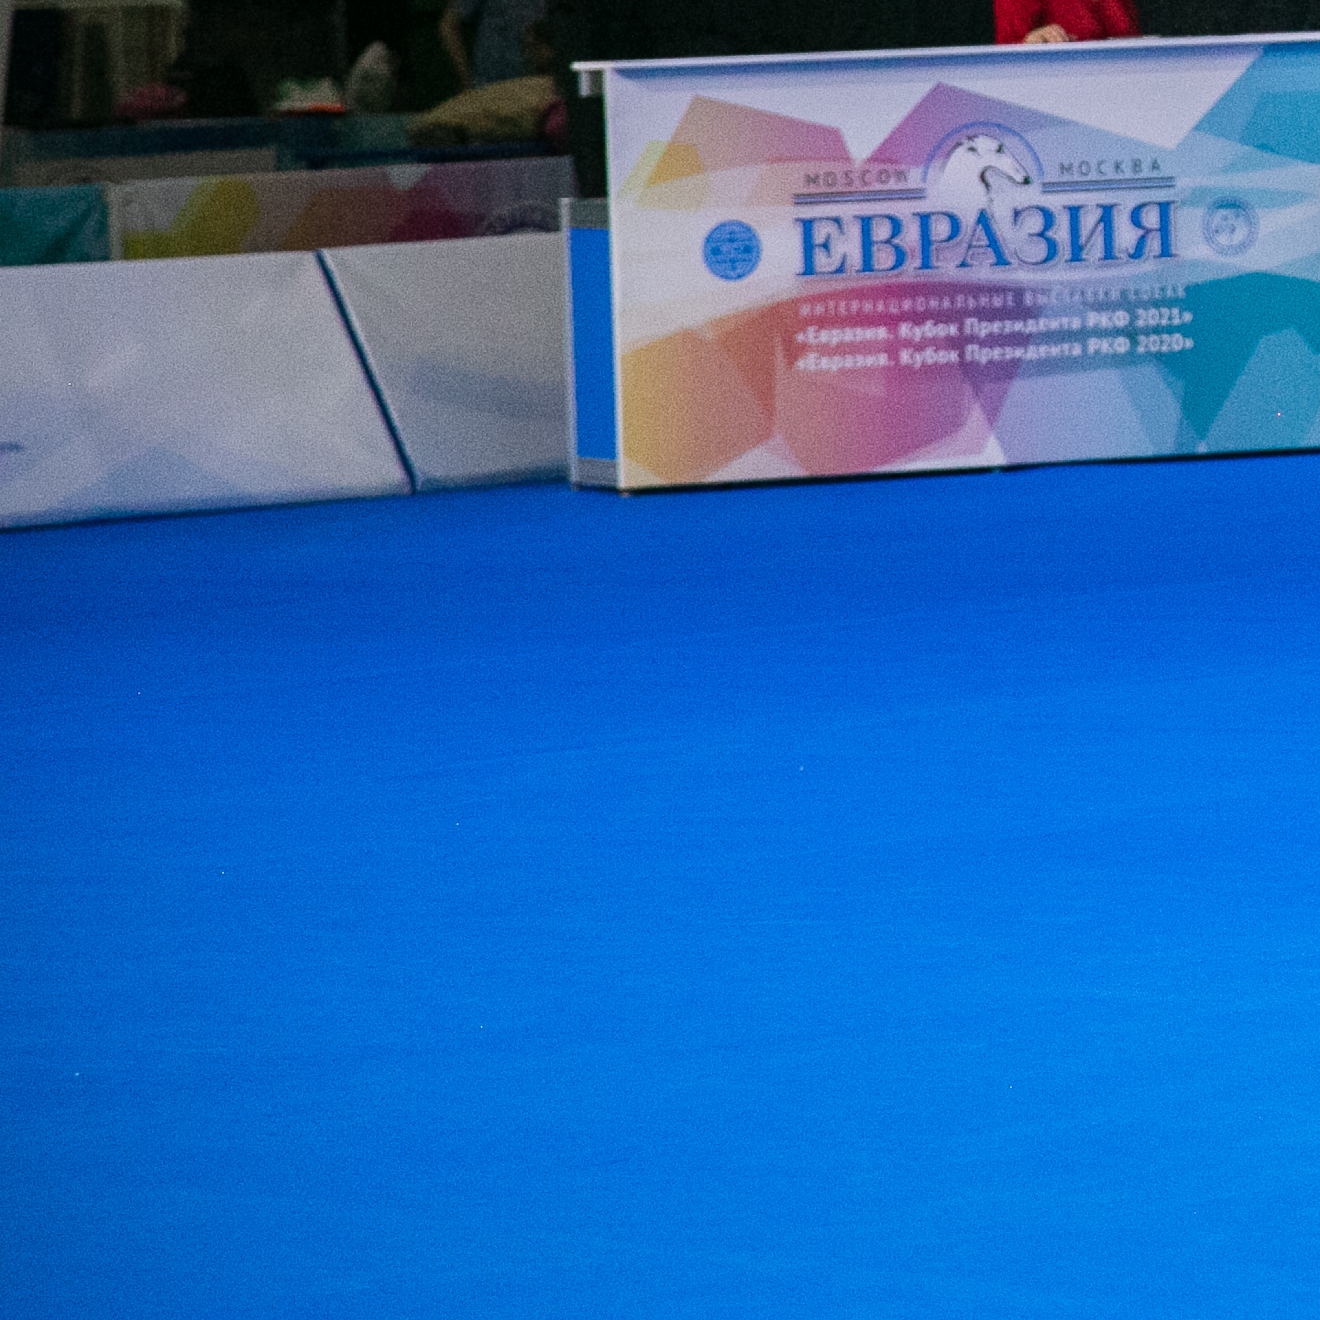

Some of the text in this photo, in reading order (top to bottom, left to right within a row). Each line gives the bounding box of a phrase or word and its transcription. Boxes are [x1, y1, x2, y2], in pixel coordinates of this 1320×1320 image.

[804, 164, 909, 189] MOSCOW
[1057, 158, 1163, 177] МОСКВА
[794, 199, 1178, 277] ЕВРАЗИЯ
[899, 320, 959, 341] Кубок
[963, 315, 1083, 338] Президента
[1086, 310, 1130, 329] РКФ
[899, 346, 960, 368] Кубок
[964, 342, 1083, 364] Президента
[1086, 336, 1131, 356] РКФ
